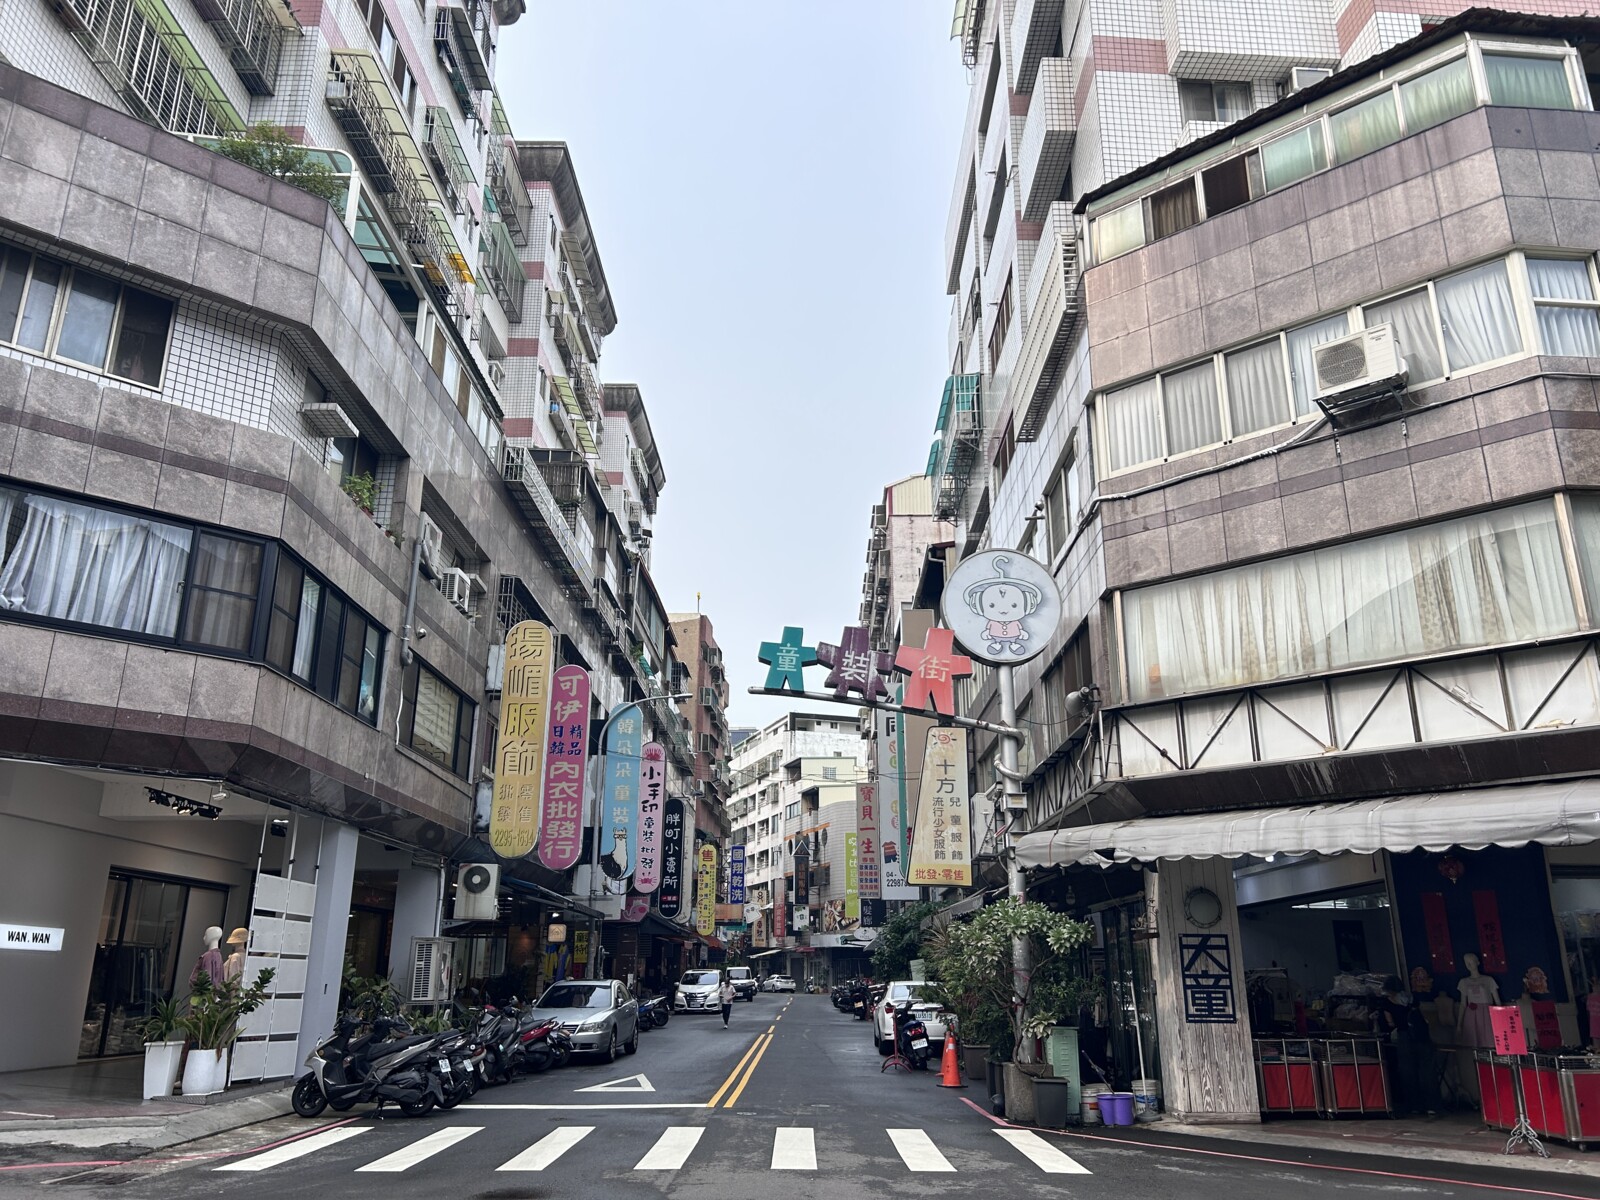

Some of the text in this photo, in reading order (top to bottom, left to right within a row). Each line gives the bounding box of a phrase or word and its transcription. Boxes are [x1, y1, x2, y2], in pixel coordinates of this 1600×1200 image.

[776, 643, 950, 684] 童裝街
[554, 675, 584, 722] 可伊
[549, 725, 566, 758] 日韓
[567, 724, 584, 756] 精品
[612, 718, 634, 824] 韓朵朵童裝
[935, 758, 956, 794] 十方
[497, 783, 514, 823] 批發
[518, 783, 534, 823] 零售
[544, 761, 580, 860] 內衣批發行
[859, 785, 876, 855] 寶貝一生
[932, 796, 946, 861] 流行少女服飾
[949, 796, 963, 861] 兒童服飾
[701, 849, 714, 862] 售
[731, 849, 744, 901] 國翔乾洗
